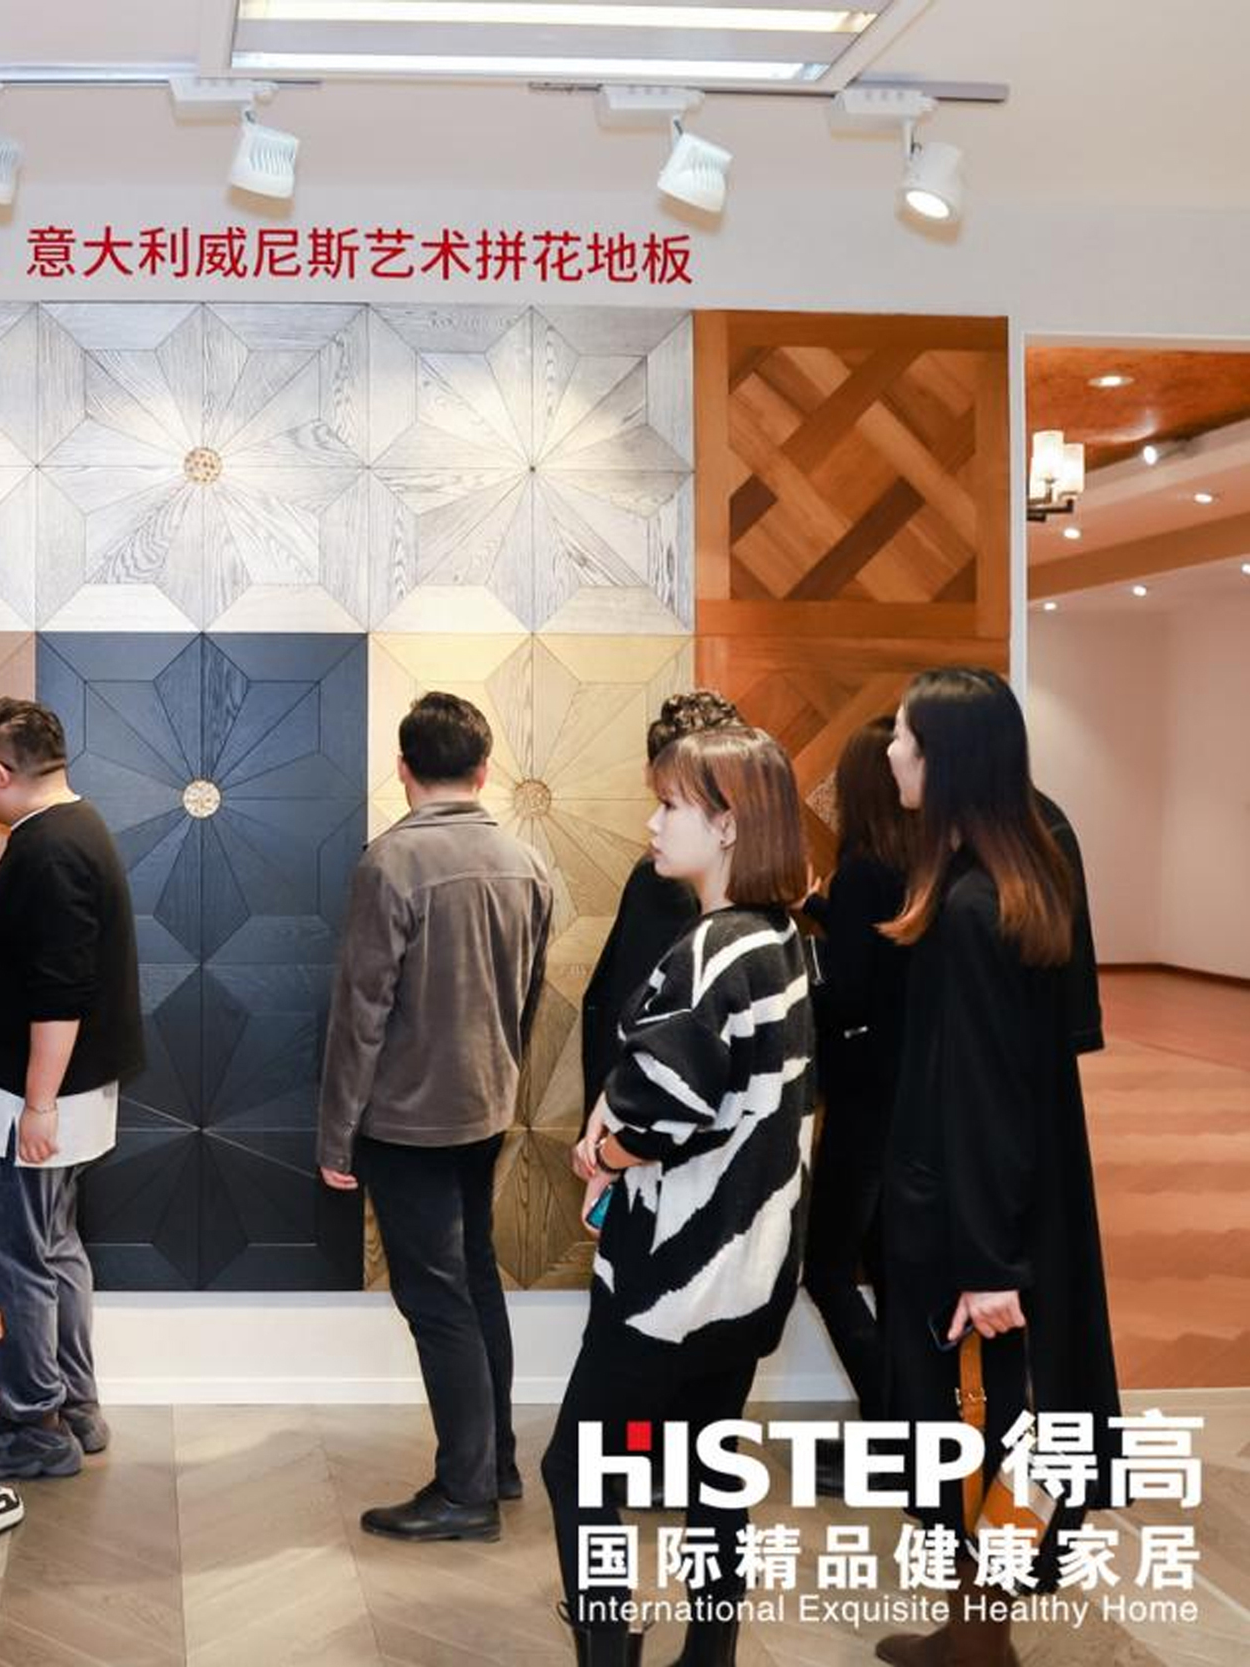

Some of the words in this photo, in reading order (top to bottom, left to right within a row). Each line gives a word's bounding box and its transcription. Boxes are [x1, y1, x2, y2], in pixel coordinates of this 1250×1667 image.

[28, 225, 693, 286] 意大利威尼斯艺术拼花地板
